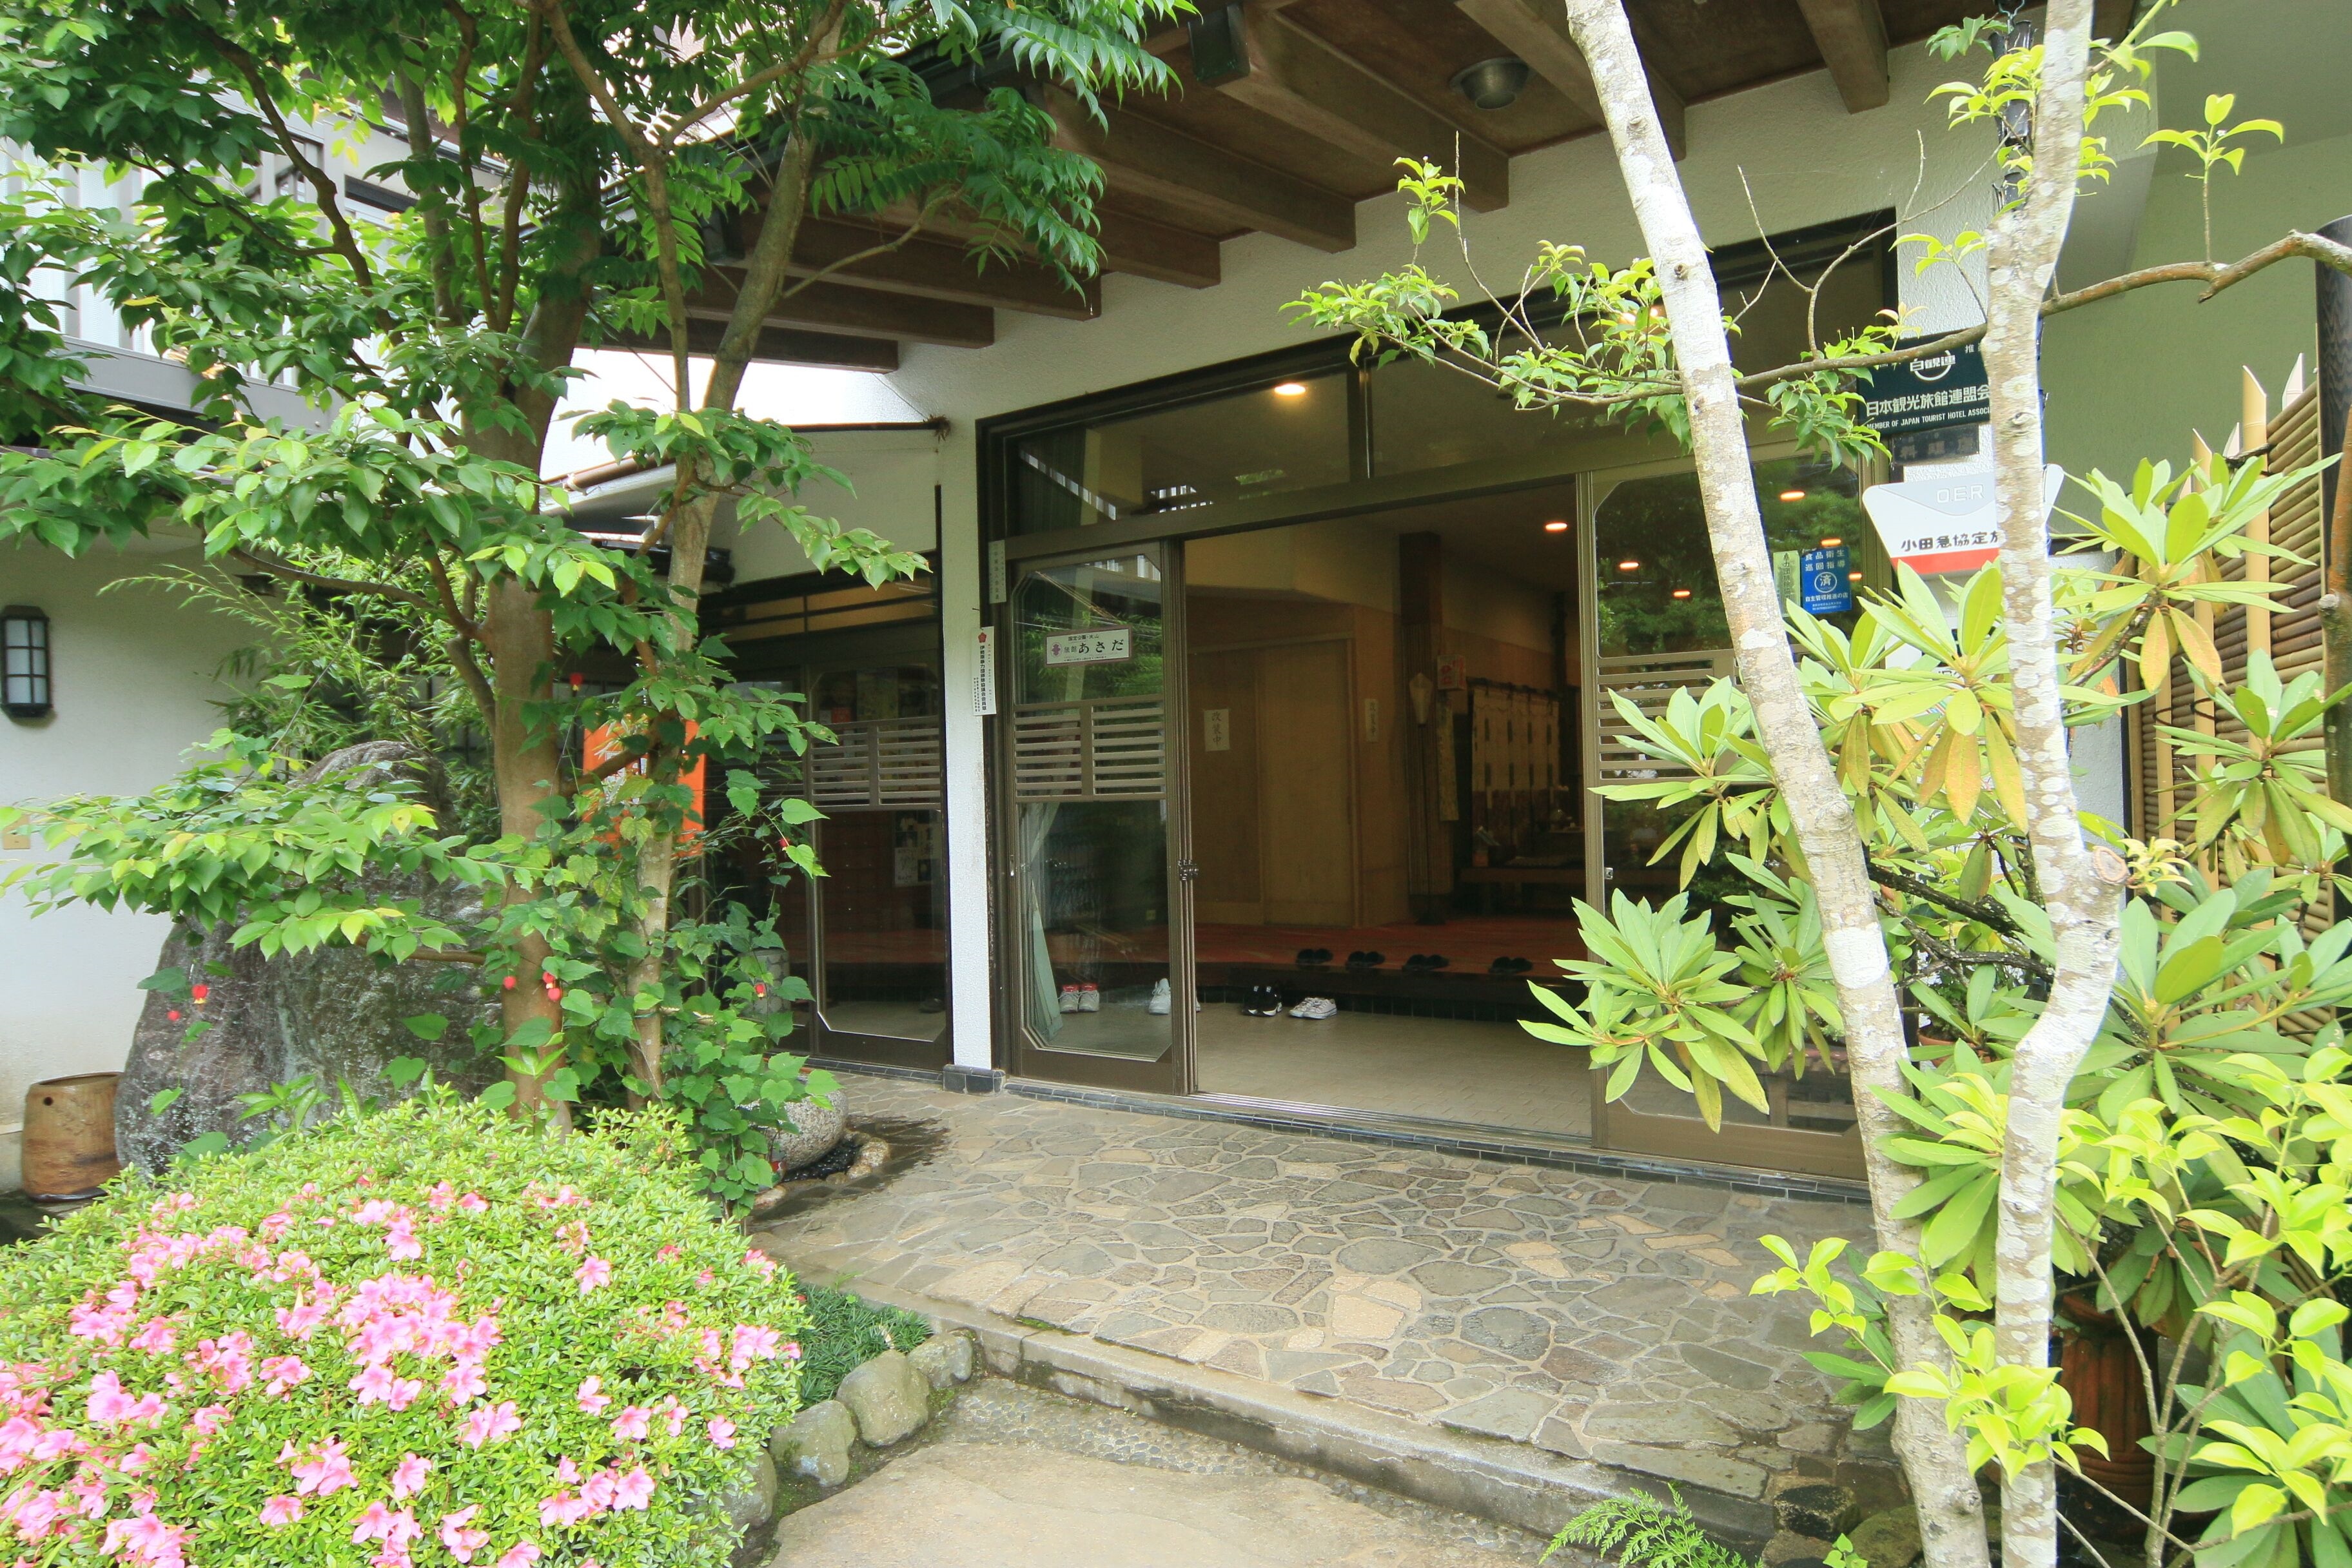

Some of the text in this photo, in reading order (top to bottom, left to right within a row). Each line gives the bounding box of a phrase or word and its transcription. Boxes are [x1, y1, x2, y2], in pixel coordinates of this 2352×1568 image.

[1867, 385, 1990, 416] 日本観光旅館連盟会
[1867, 422, 1890, 430] MEMBER
[1901, 417, 1920, 426] JAPAN
[1922, 413, 1946, 422] TOURIST
[1948, 411, 1966, 419] HOTEL
[1805, 549, 1845, 561] 食品衛生
[1805, 560, 1845, 571] 巡回指導
[1819, 574, 1832, 586] 済
[1805, 593, 1848, 602] 自主管理推進の店
[1079, 639, 1124, 654] あさだ
